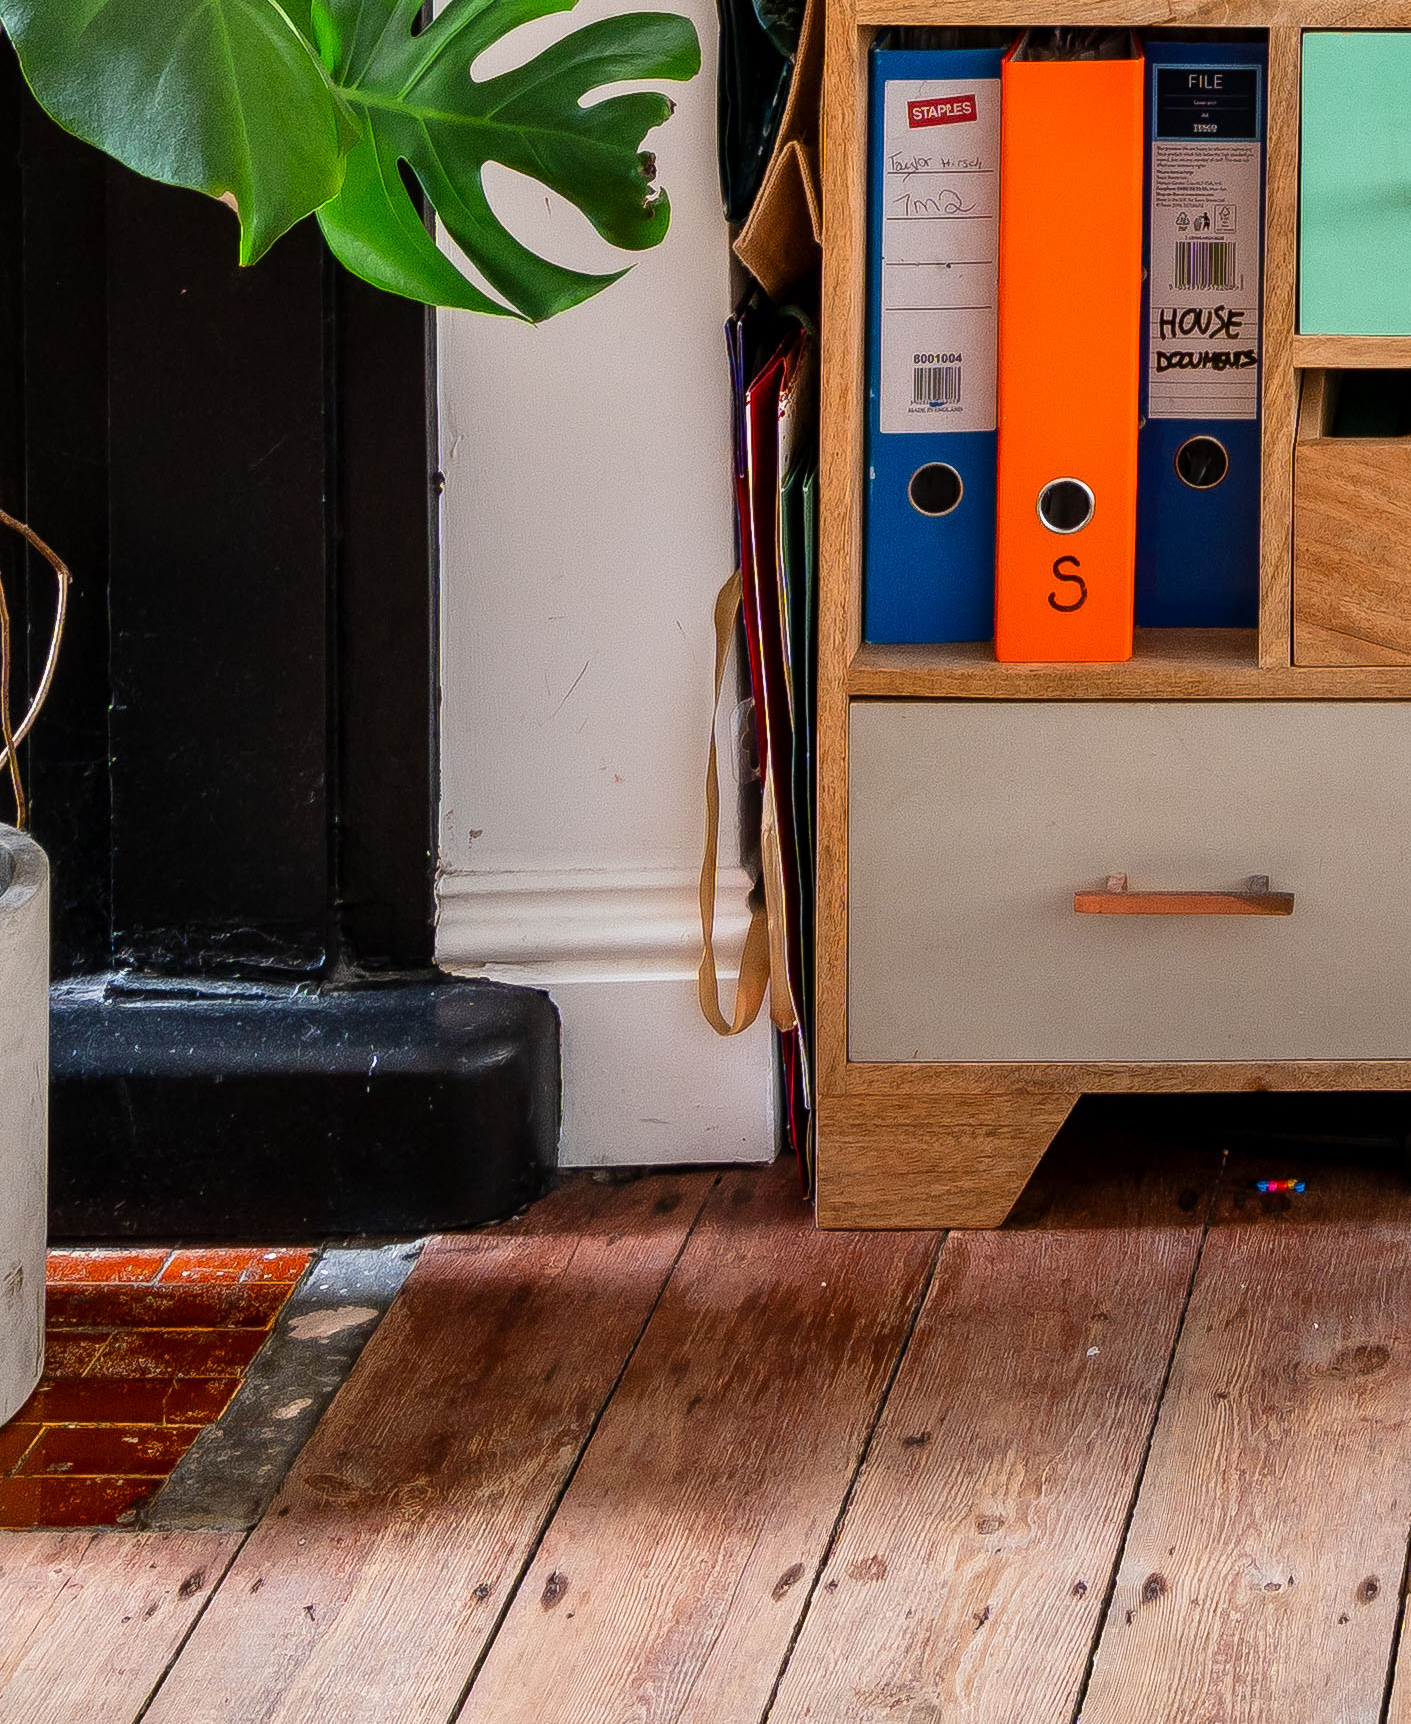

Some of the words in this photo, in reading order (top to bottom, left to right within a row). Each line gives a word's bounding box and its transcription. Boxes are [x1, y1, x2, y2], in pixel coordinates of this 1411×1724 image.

[1188, 73, 1224, 90] FILE
[912, 102, 972, 120] STAPLES
[1159, 306, 1245, 339] HOUSE
[914, 353, 963, 364] 8001004
[1047, 554, 1088, 612] S
